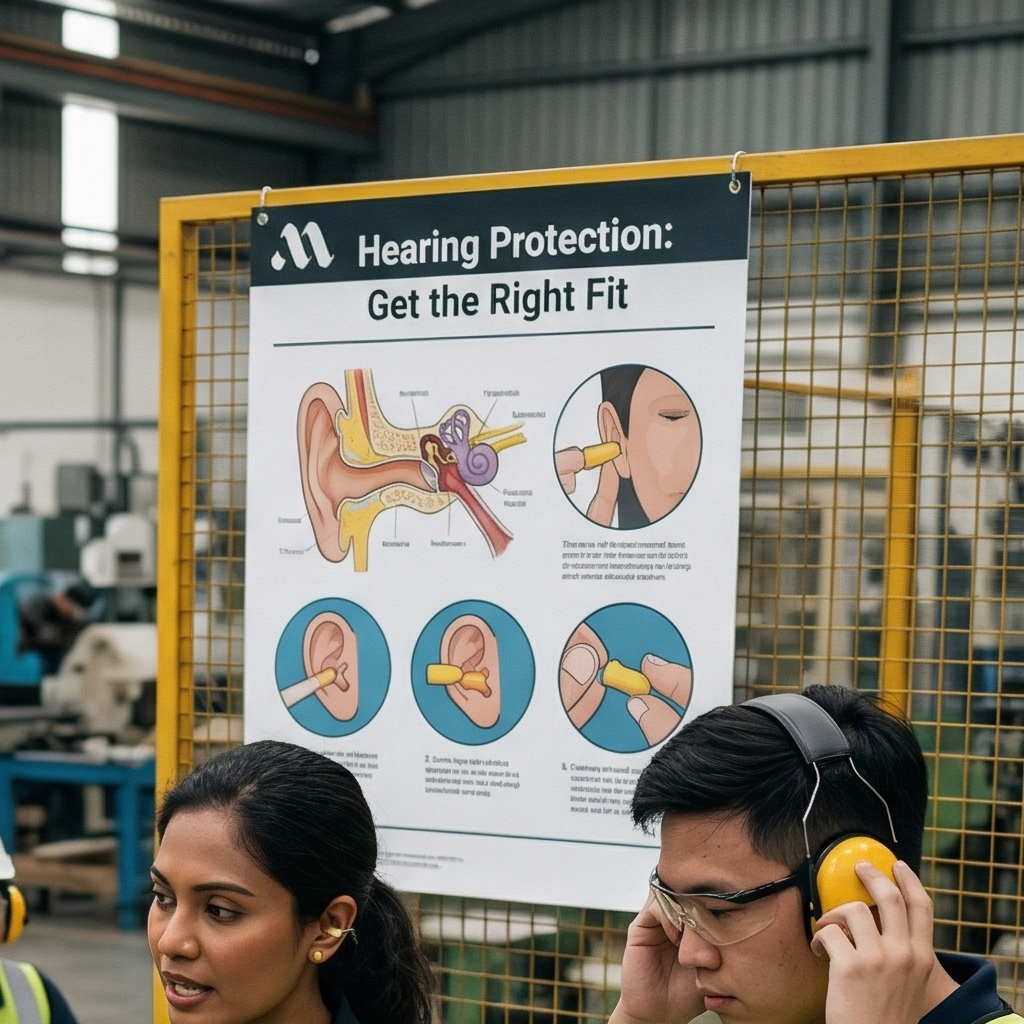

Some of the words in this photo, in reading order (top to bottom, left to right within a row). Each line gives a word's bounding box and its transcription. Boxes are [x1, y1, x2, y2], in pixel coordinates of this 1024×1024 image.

[358, 230, 479, 268] Hearing
[490, 217, 674, 259] Protection:
[367, 289, 420, 320] Get
[428, 284, 479, 317] the
[489, 280, 575, 322] Right
[586, 276, 629, 310] Fit
